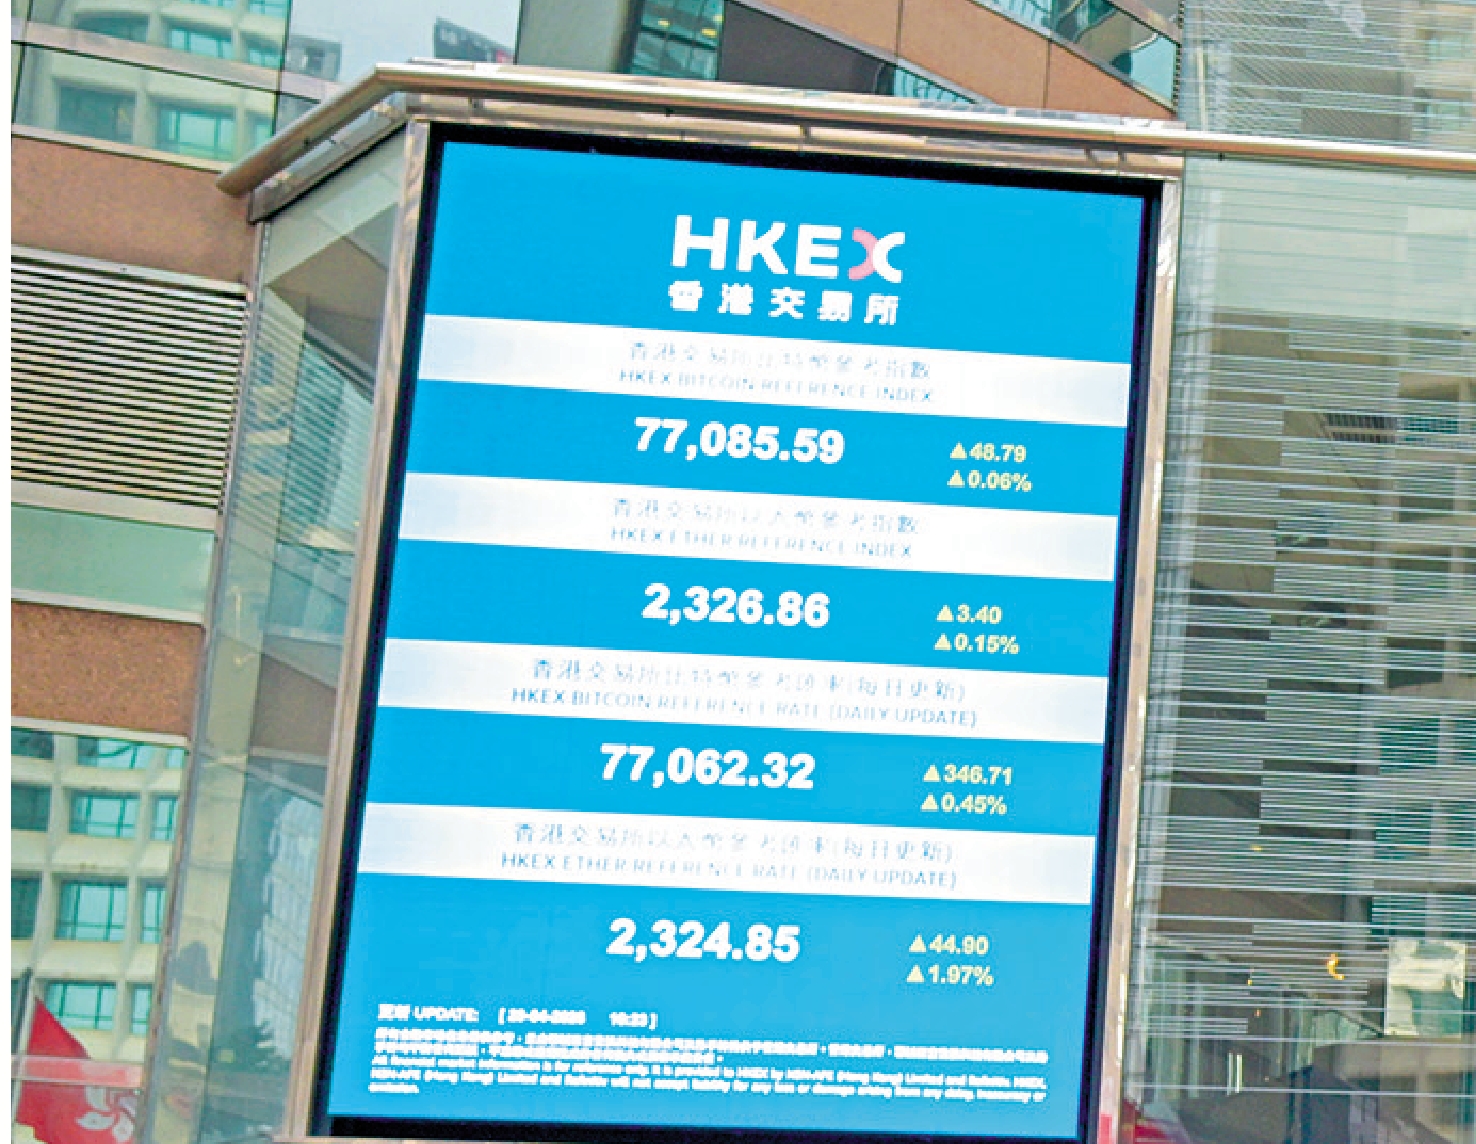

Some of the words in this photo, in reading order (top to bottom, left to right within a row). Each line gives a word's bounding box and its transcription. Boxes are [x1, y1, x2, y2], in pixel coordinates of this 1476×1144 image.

[671, 215, 906, 284] HKEX
[669, 280, 901, 325] 香港交易所
[635, 417, 846, 464] 77,085.59
[970, 443, 1026, 462] 48.79
[969, 470, 1031, 491] 0.06%
[643, 583, 829, 627] 2,326.86
[958, 605, 1001, 624] 3.40
[955, 633, 1018, 654] 0.15%
[512, 687, 565, 706] HKEX
[895, 708, 978, 728] UPDATE)
[601, 743, 815, 788] 77,062.32
[945, 765, 1011, 784] 346.71
[941, 793, 1006, 814] 0.45%
[500, 852, 556, 871] HKEX
[873, 873, 958, 891] UPDATE)
[606, 918, 800, 962] 2,324.85
[930, 935, 988, 954] 44.90
[929, 965, 993, 985] 1.97%
